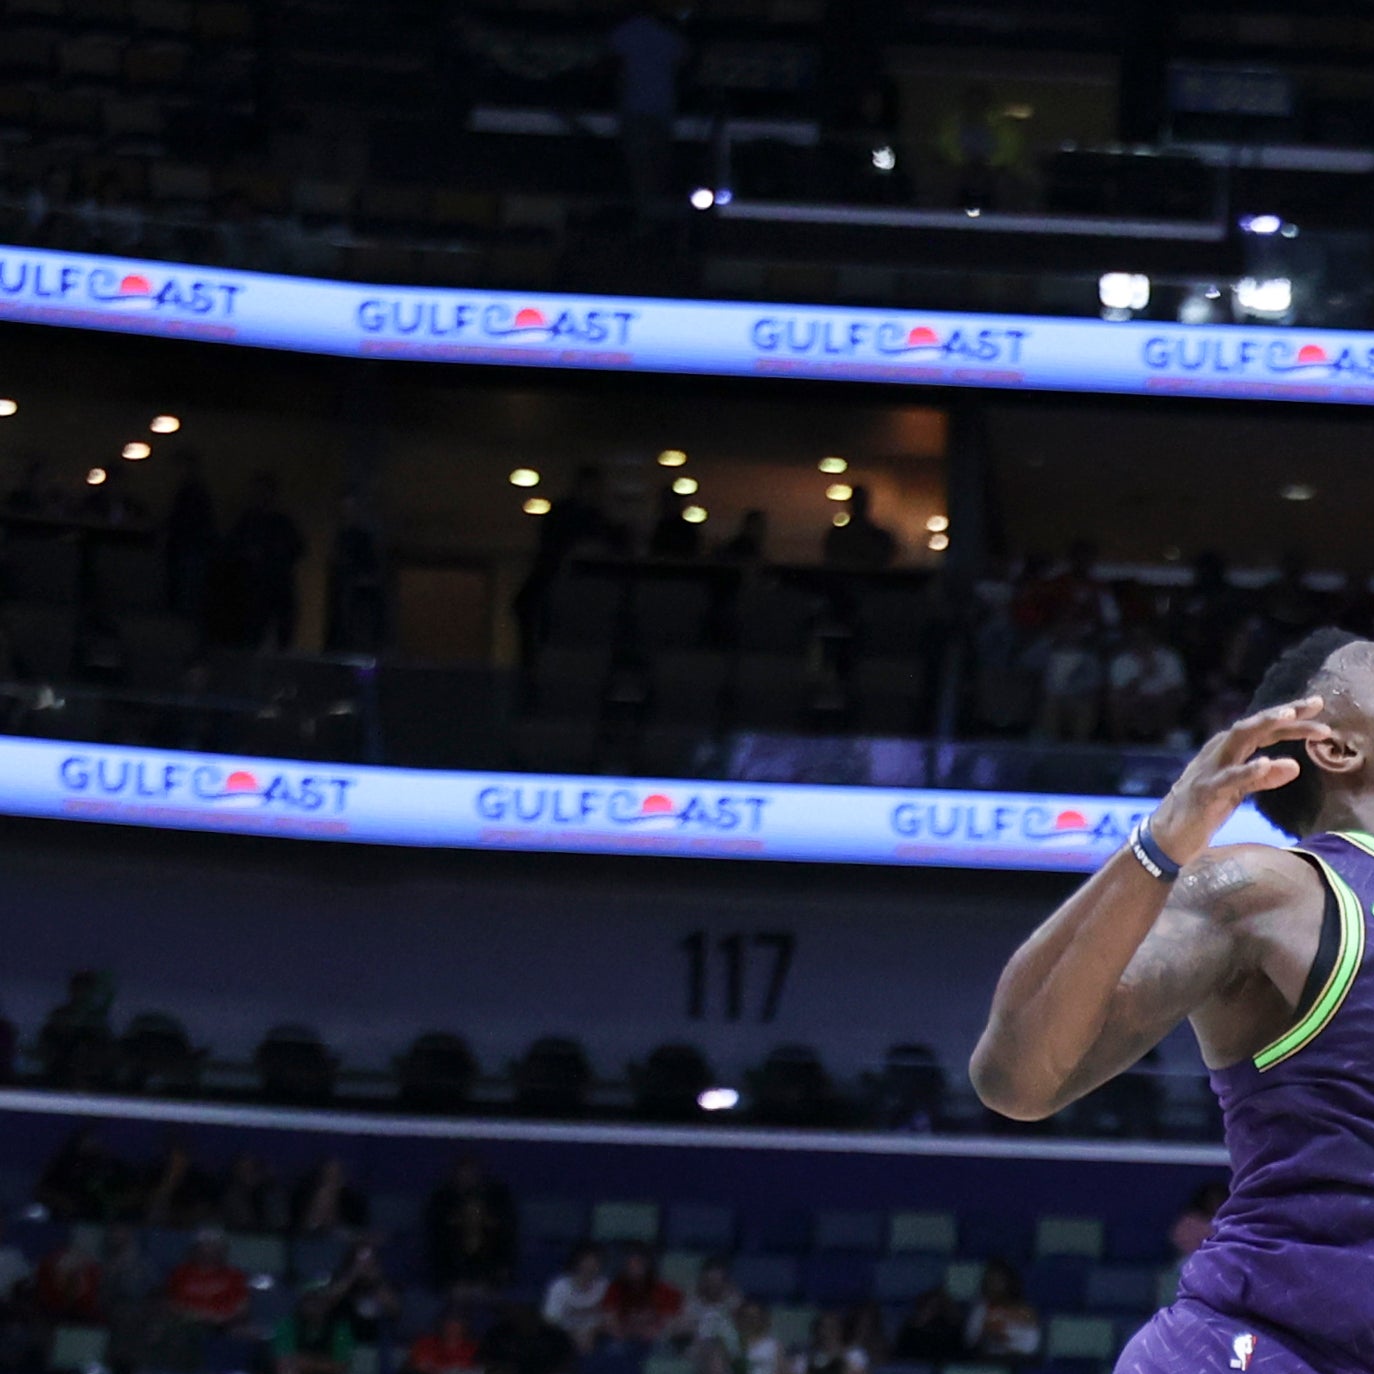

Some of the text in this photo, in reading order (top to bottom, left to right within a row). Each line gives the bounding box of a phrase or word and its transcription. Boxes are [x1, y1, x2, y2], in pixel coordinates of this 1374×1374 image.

[0, 260, 245, 316] ULFCOAST
[357, 297, 640, 346] GULFCOAST
[751, 316, 1031, 364] GULFCOAST
[59, 754, 357, 814] GULFCOAST
[475, 786, 773, 831] GULFCOAST
[681, 930, 796, 1021] 117
